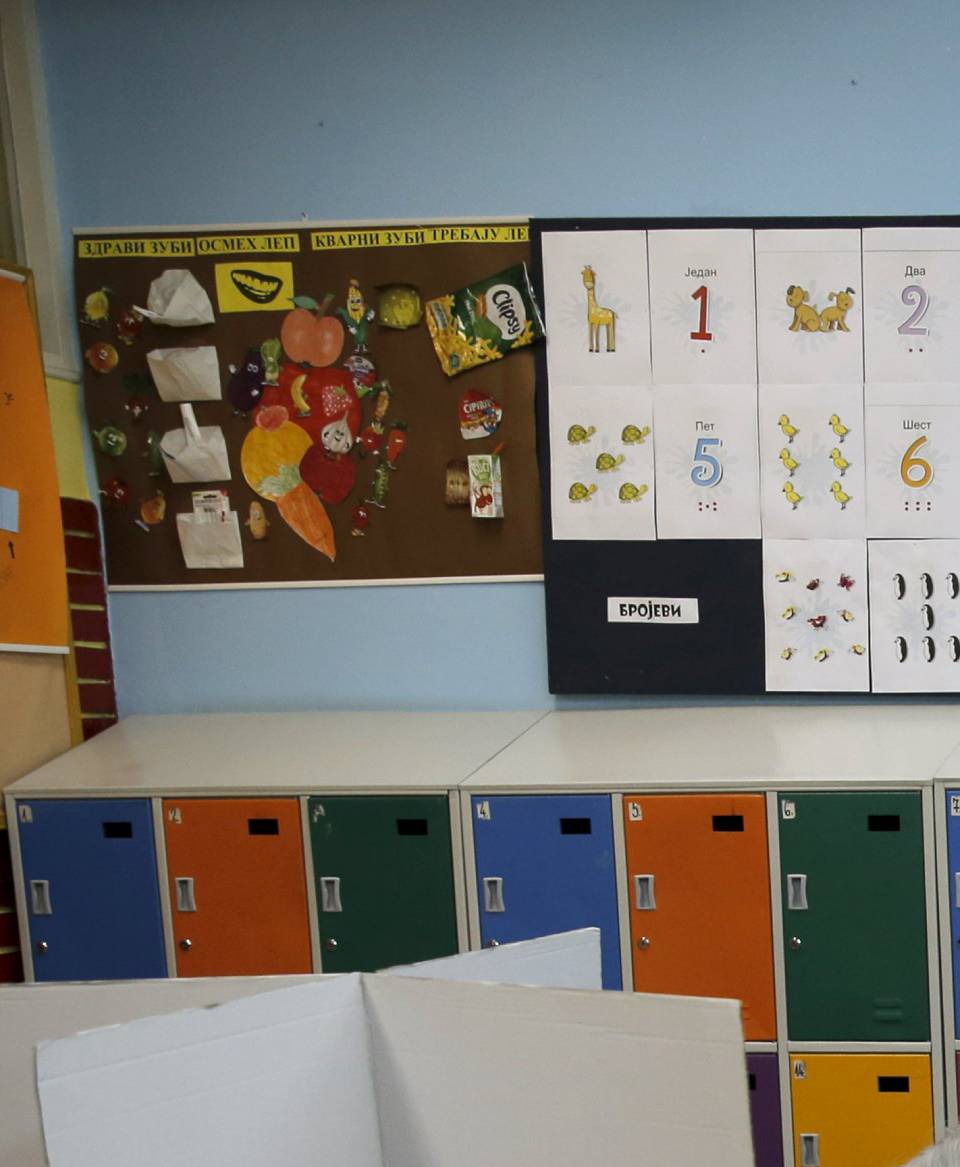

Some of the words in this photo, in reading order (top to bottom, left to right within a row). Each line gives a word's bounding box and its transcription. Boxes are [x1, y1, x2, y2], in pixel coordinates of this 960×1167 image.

[84, 241, 145, 256] ЗДРАВИ
[151, 240, 192, 254] ЗУБИ
[199, 238, 257, 252] ОСМЕХ
[261, 236, 295, 250] ЛЕП
[315, 232, 379, 248] КВАРНИ
[386, 230, 425, 245] ЗУБИ
[431, 227, 500, 242] ТРЕБАЈУ
[685, 267, 717, 279] Један
[904, 265, 926, 278] Два
[492, 289, 521, 336] Clipsy
[690, 285, 713, 341] 1
[897, 285, 930, 335] 2
[695, 420, 715, 432] Пет
[903, 419, 932, 430] Шест
[690, 438, 723, 488] 5
[900, 436, 934, 488] 6
